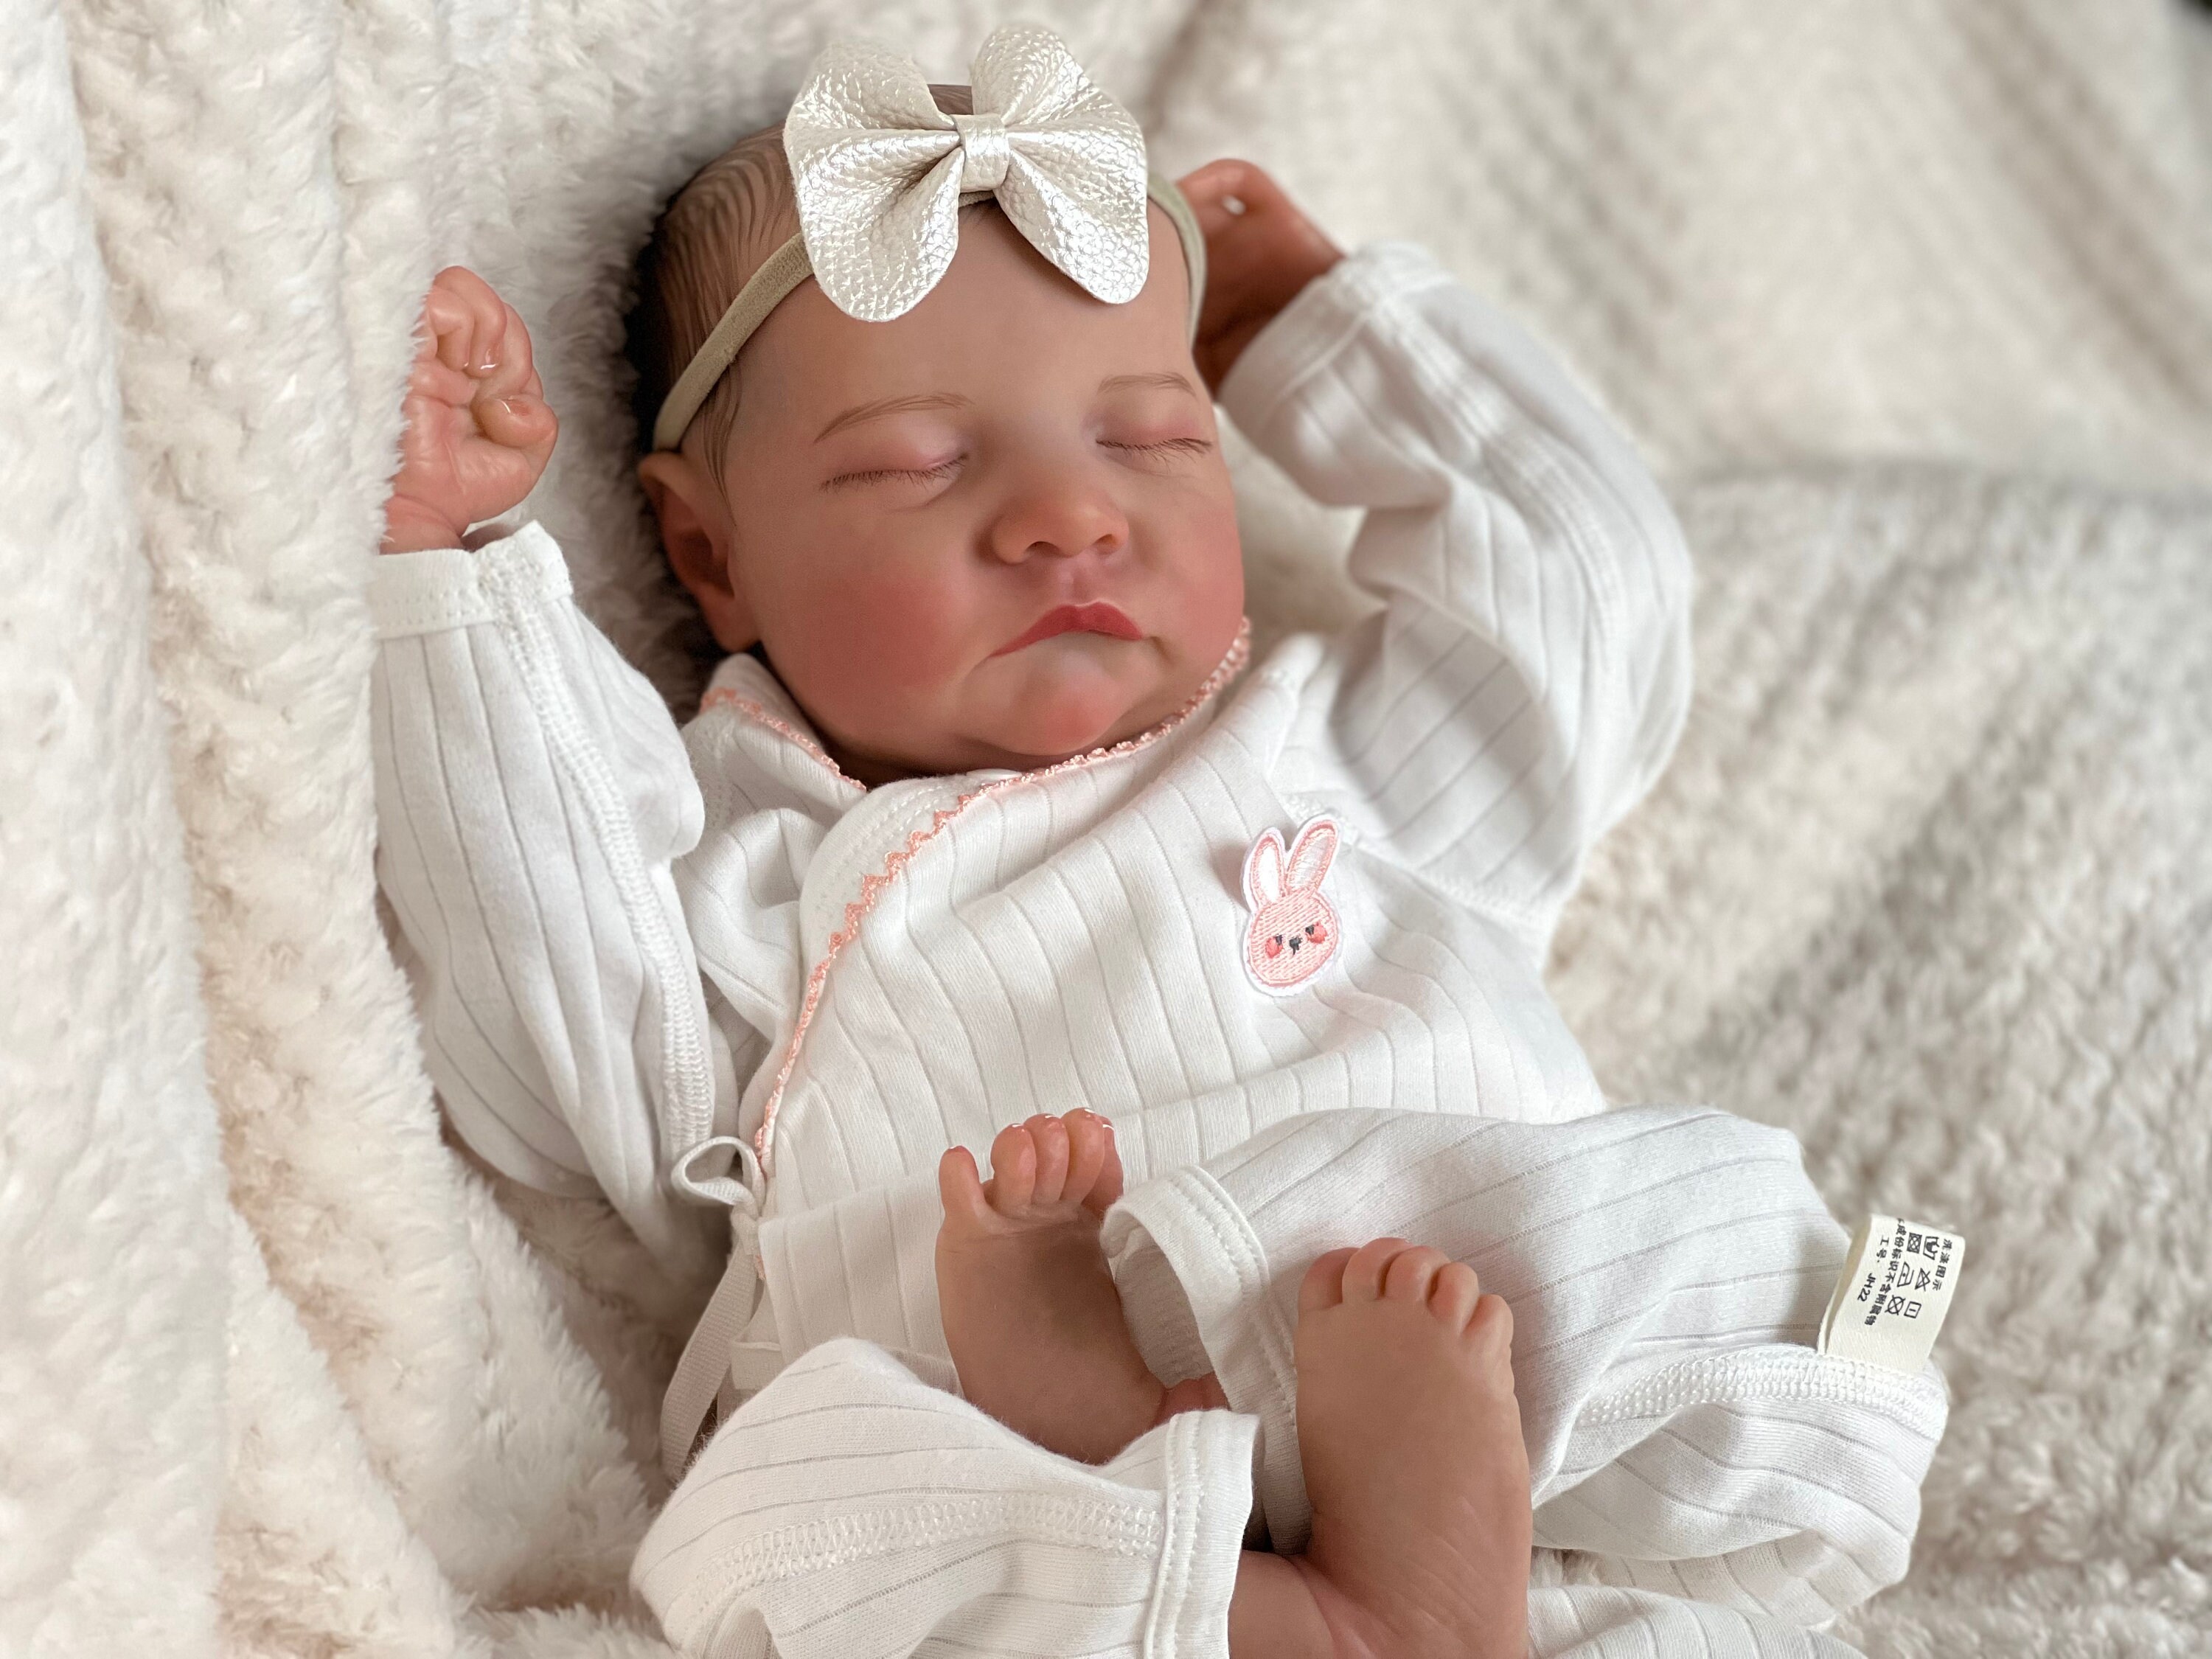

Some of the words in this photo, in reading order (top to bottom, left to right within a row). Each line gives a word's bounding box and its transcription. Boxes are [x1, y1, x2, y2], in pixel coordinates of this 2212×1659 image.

[1932, 1238, 1952, 1291] 洗涤图示
[1857, 1273, 1877, 1302] JH22
